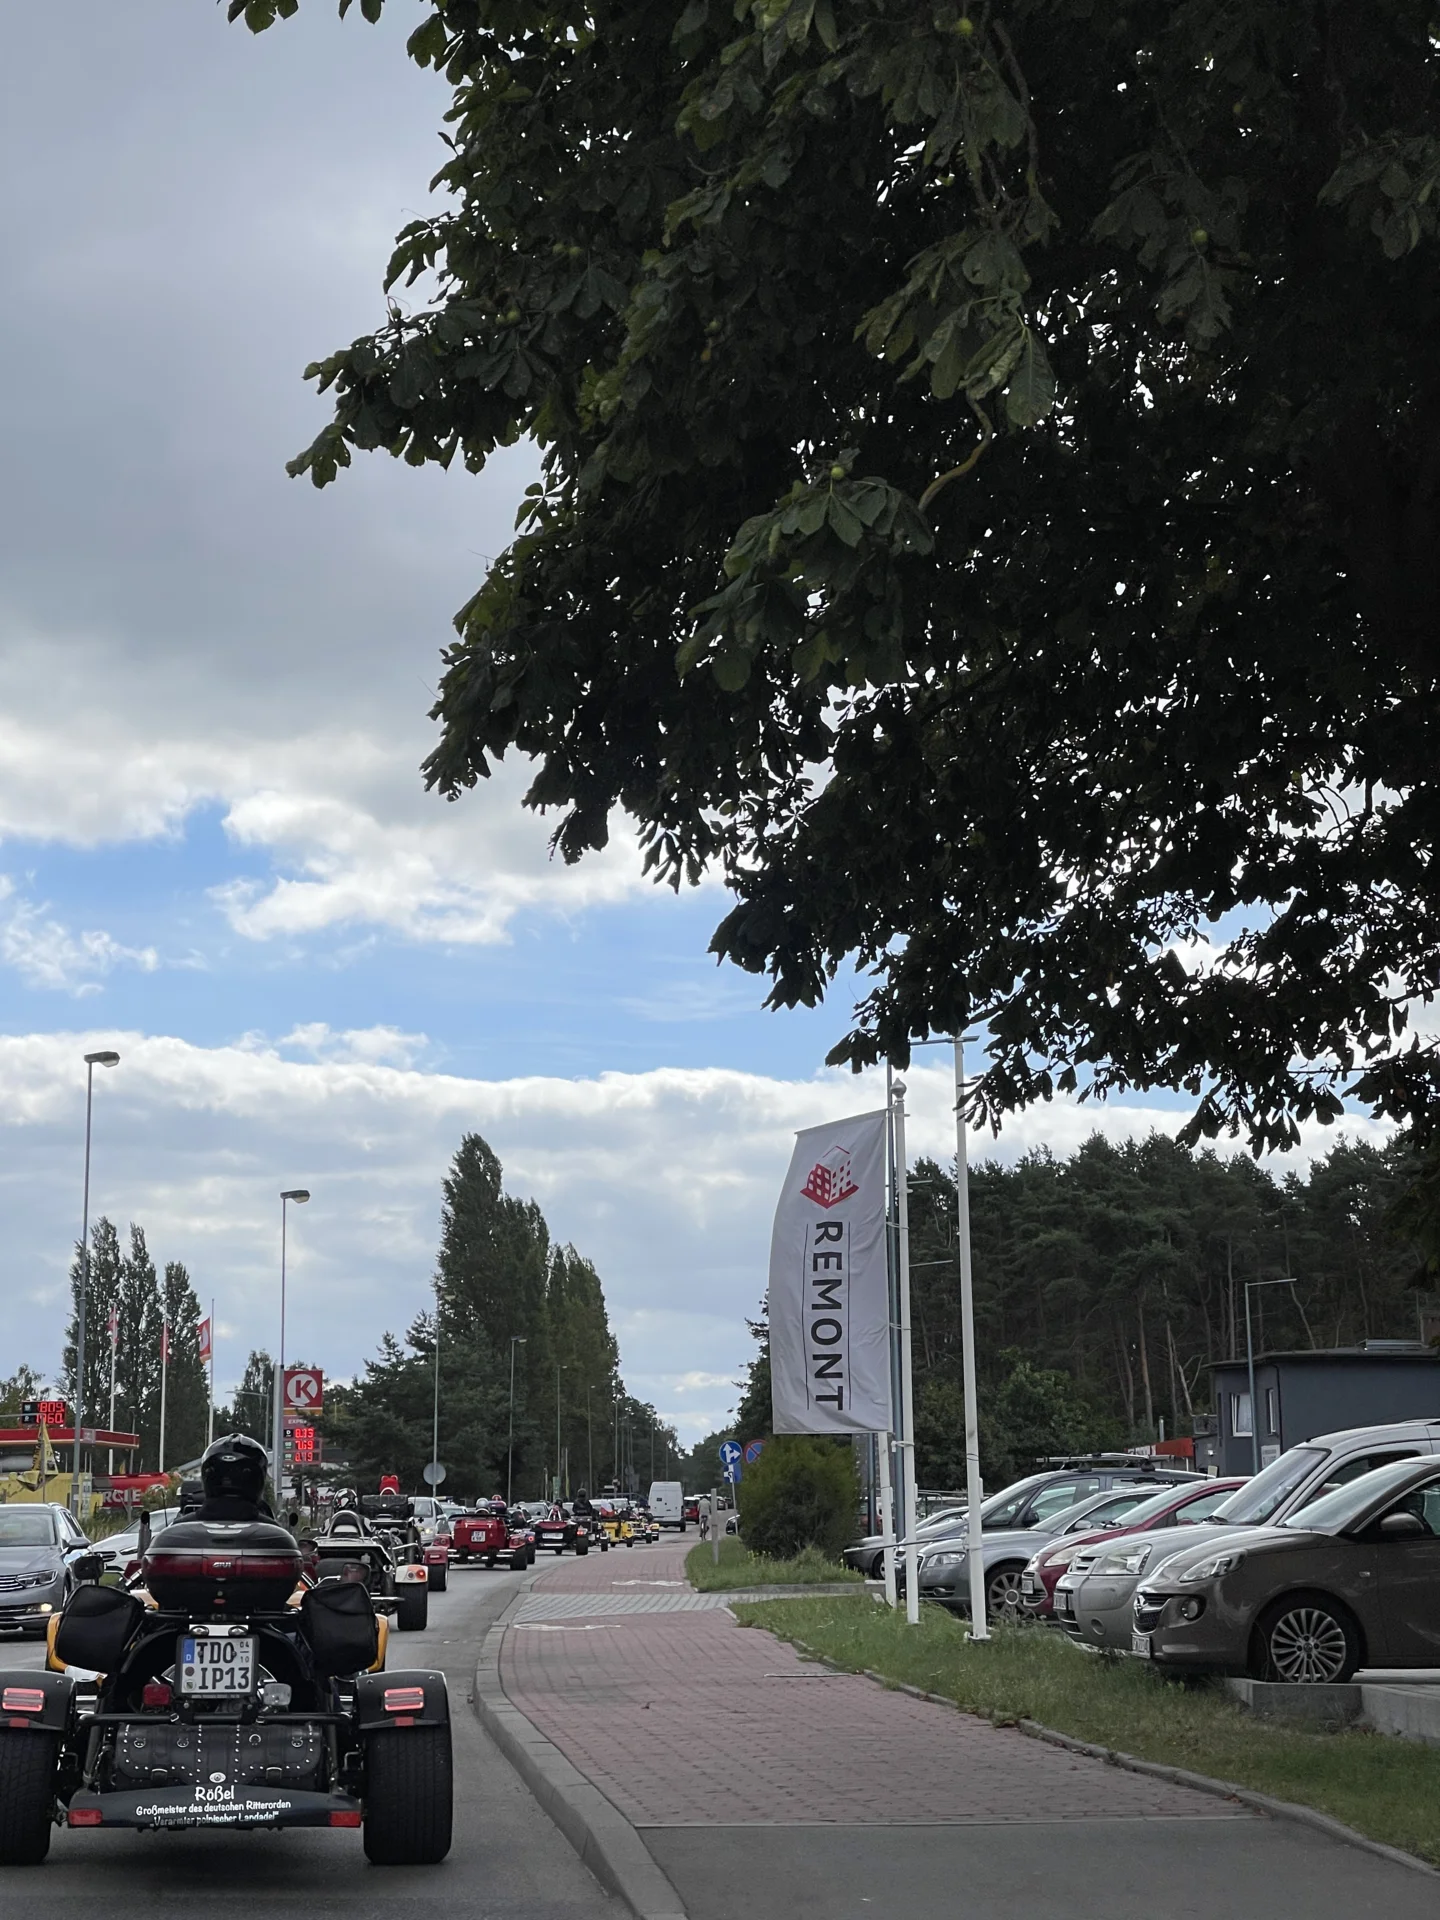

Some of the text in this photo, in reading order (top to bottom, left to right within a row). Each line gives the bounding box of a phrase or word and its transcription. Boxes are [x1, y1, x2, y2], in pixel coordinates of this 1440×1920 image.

[811, 1221, 844, 1411] REMONT
[295, 1380, 314, 1401] K
[185, 1653, 192, 1661] D
[196, 1642, 235, 1664] TDO
[198, 1667, 249, 1690] IP13
[195, 1785, 235, 1802] Rößel
[136, 1799, 291, 1816] Großmeister des deutschen Ritterorden
